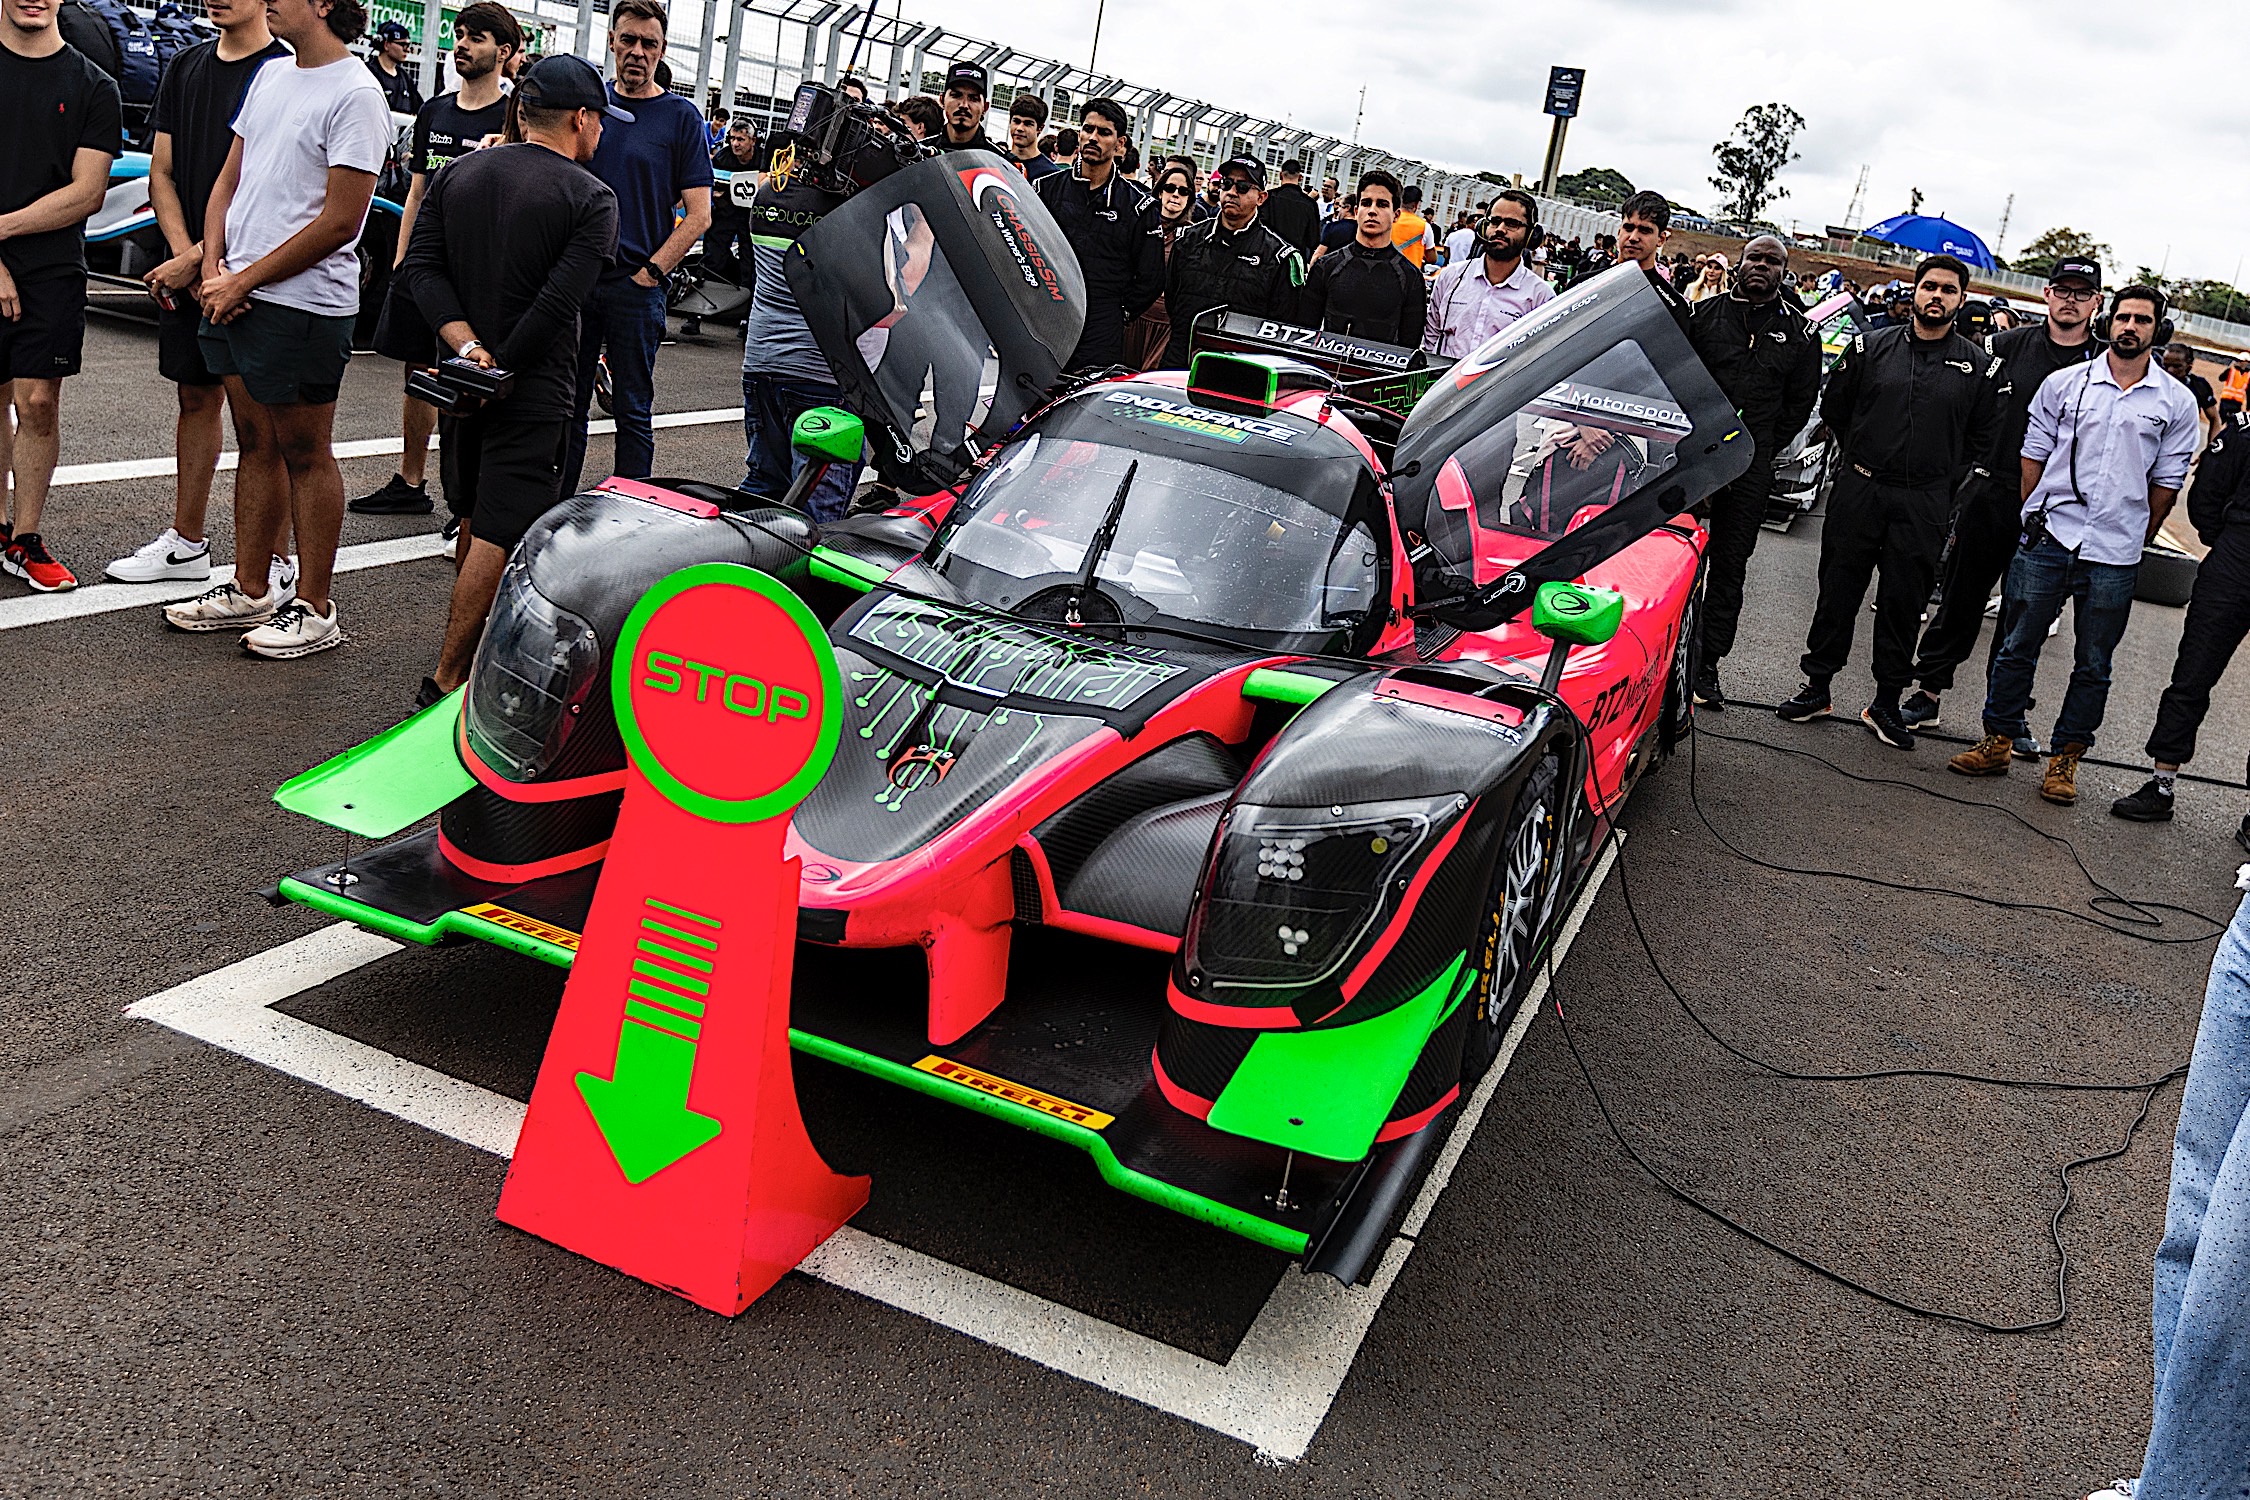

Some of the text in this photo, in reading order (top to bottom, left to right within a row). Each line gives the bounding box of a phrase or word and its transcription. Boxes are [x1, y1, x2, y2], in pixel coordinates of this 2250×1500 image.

[1021, 264, 1039, 287] Edge
[1257, 321, 1410, 366] BTZ Motorspo
[1507, 334, 1527, 350] The
[1527, 309, 1570, 337] Winner's
[1571, 293, 1599, 312] Edge
[1105, 391, 1300, 430] ENDURANCE
[1151, 411, 1242, 439] BRASIL
[644, 650, 810, 723] STOP
[1586, 674, 1630, 735] BTZ
[1394, 699, 1523, 744] SCHUSTER
[477, 908, 582, 948] PIREL
[931, 1061, 1094, 1122] PIRELLI
